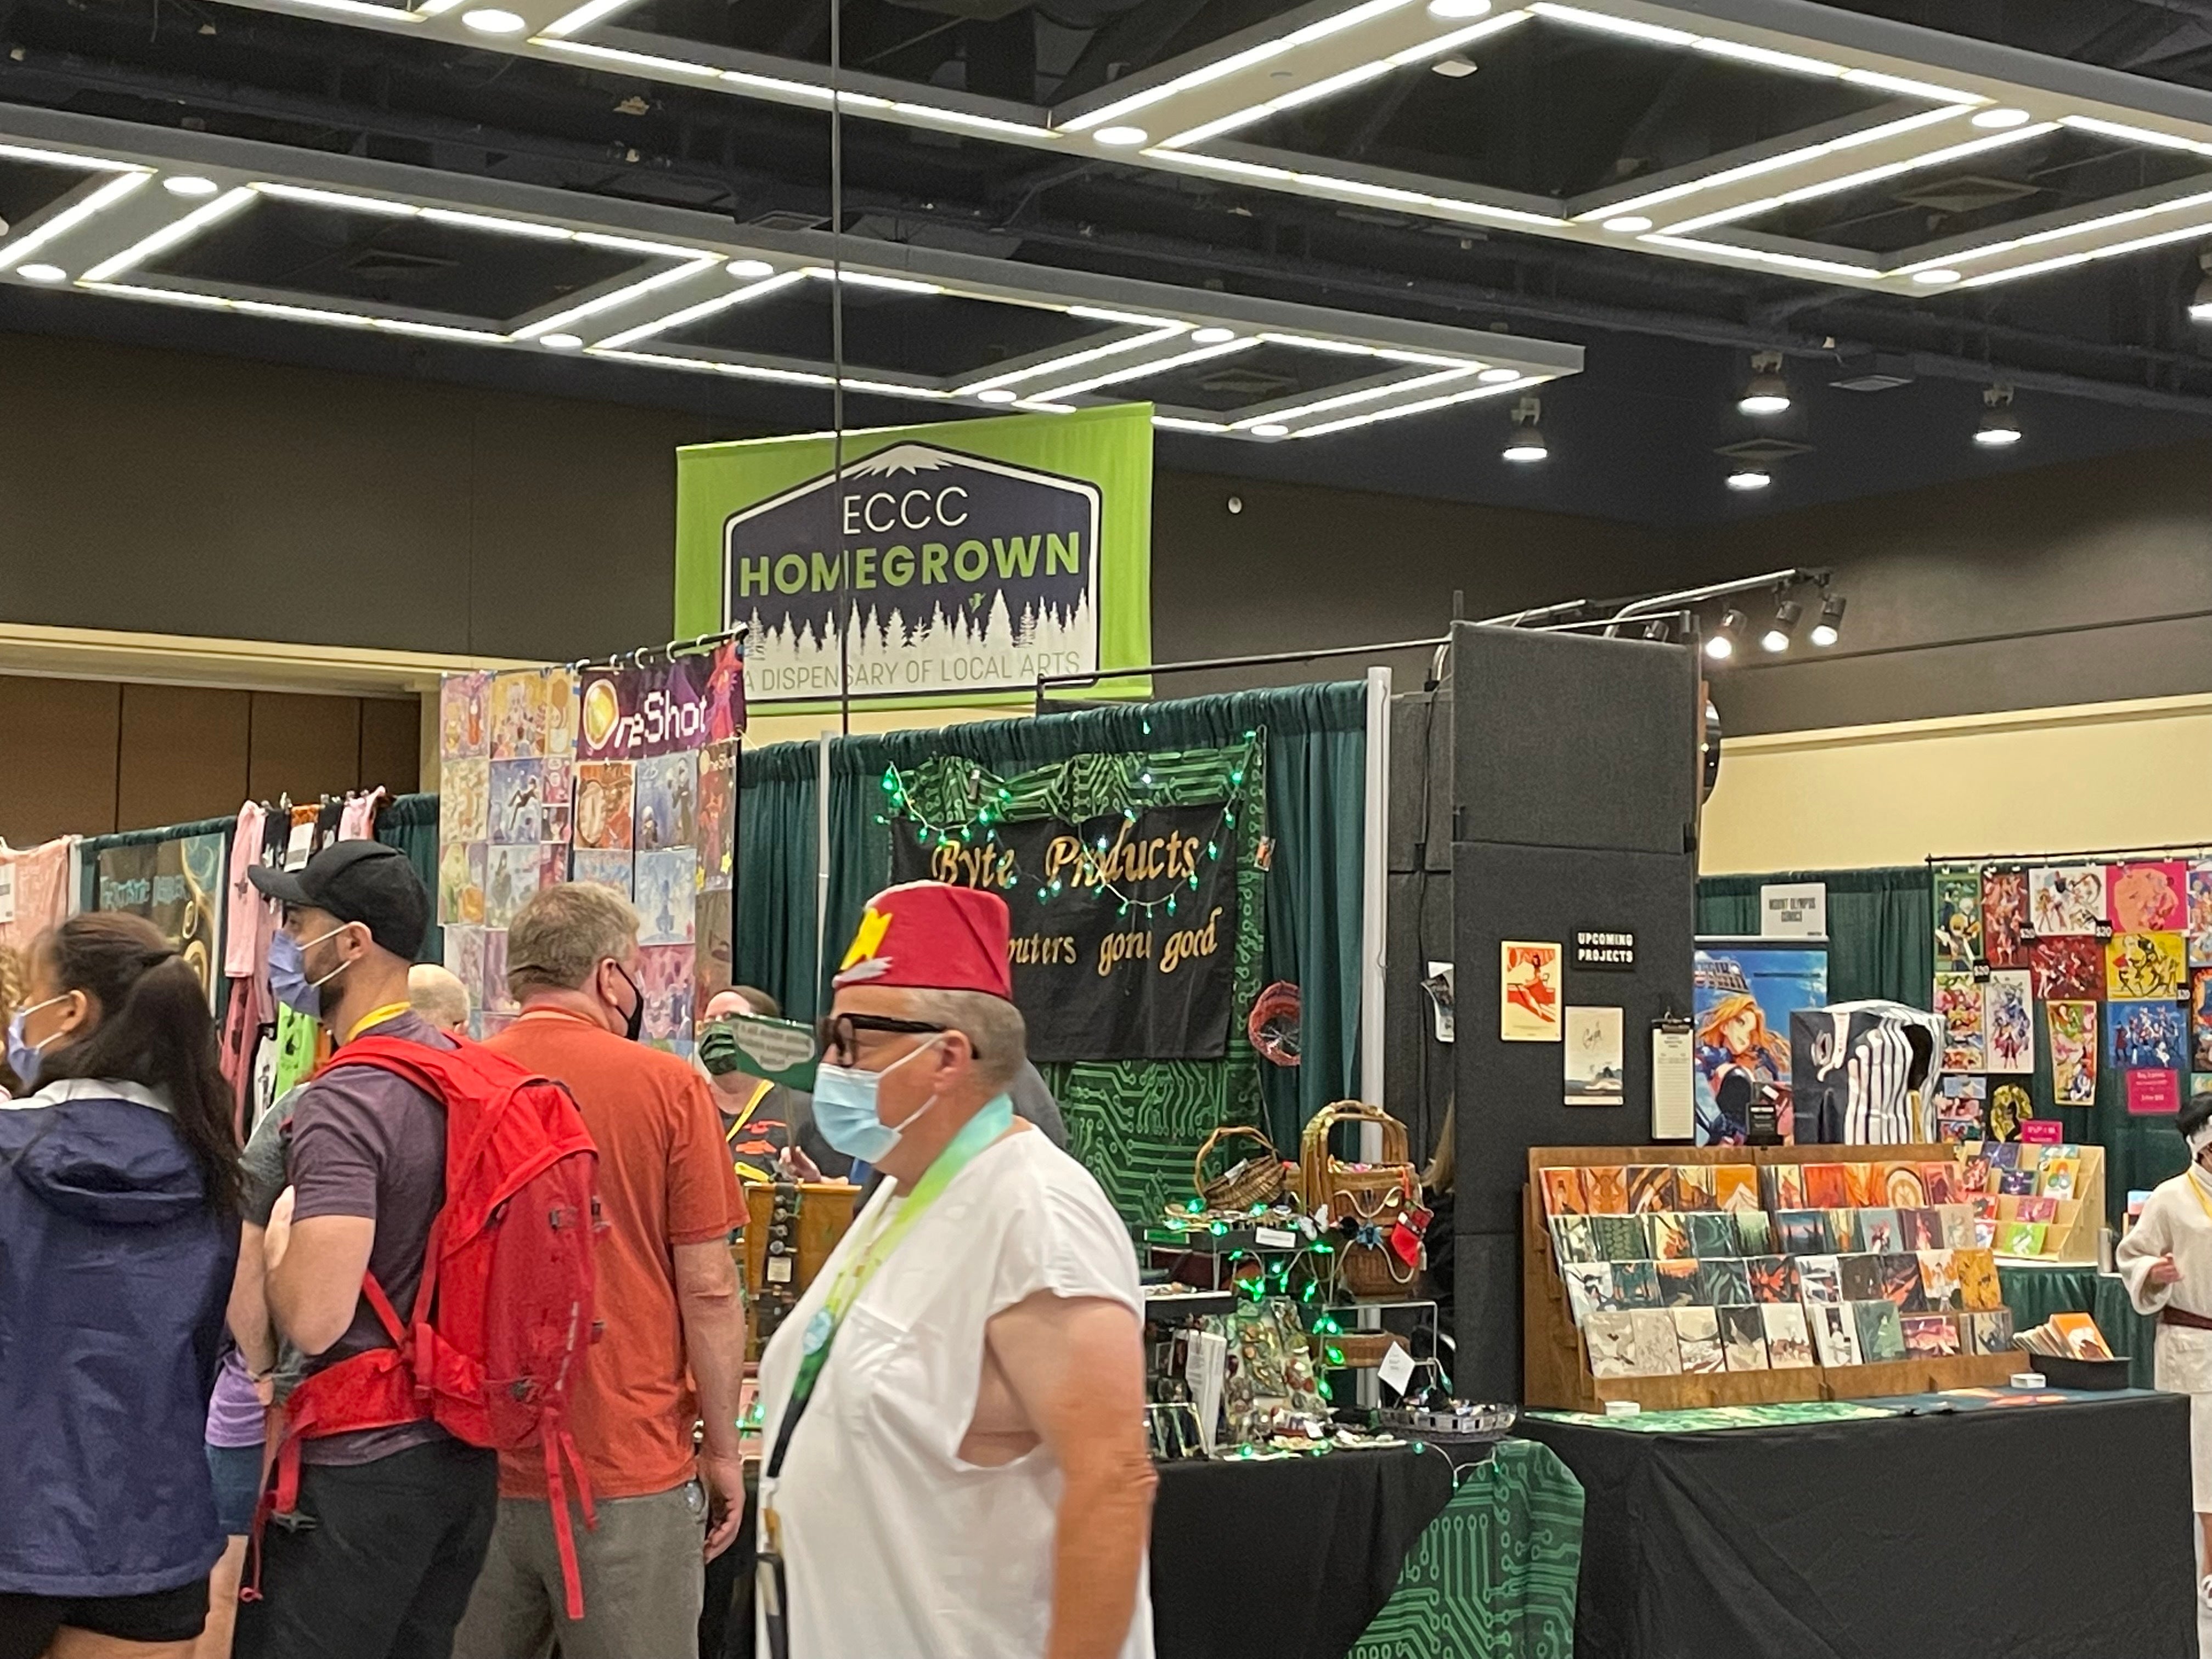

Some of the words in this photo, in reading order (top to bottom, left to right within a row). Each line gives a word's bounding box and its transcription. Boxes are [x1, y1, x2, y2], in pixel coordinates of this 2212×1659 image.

[843, 486, 968, 535] ECCC
[739, 531, 1080, 597] HOMEGROWN
[762, 662, 900, 691] DISPENSARY
[906, 659, 933, 684] OF
[940, 655, 1013, 682] LOCAL
[1019, 651, 1080, 678] ARTS
[932, 839, 1015, 889] Byte
[1577, 932, 1633, 947] UPCOMING
[1578, 948, 1633, 963] PROJECTS
